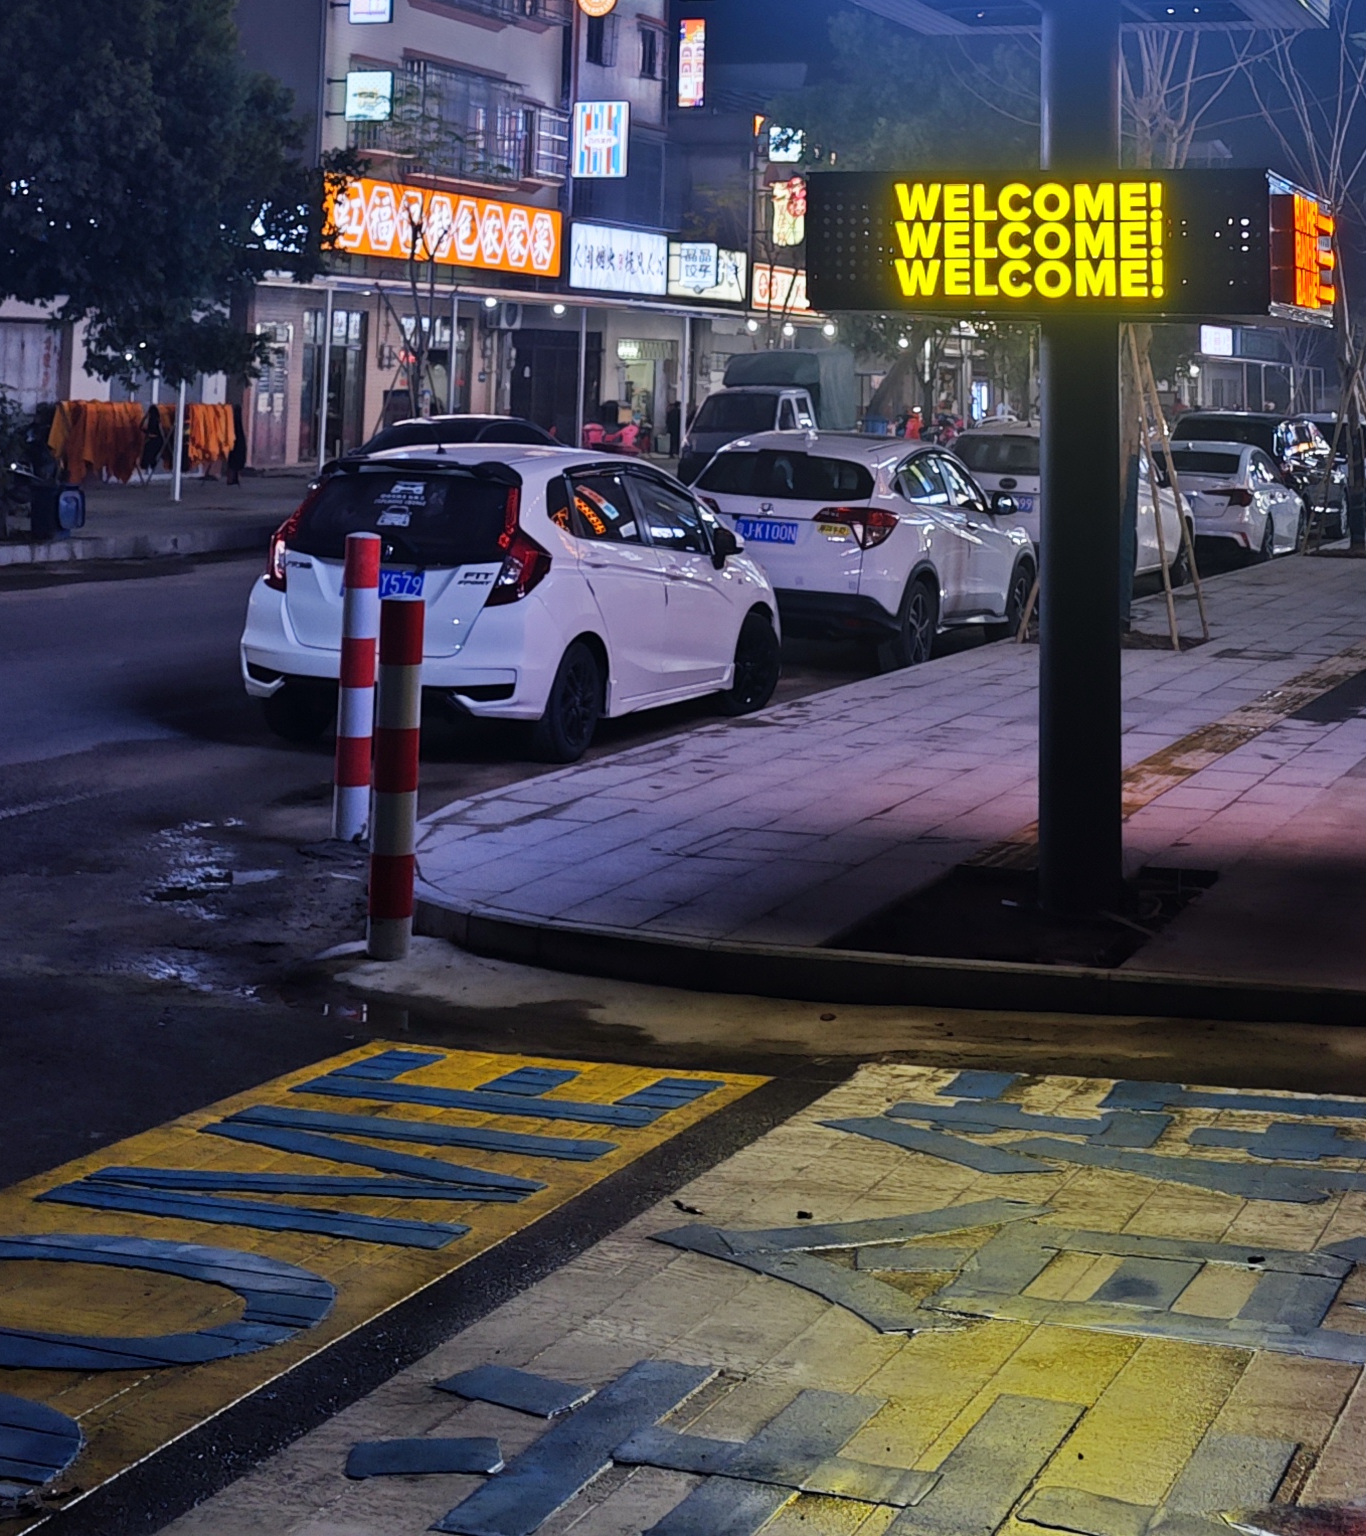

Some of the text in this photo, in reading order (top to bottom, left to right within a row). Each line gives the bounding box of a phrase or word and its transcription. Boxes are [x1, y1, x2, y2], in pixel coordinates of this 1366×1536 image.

[895, 182, 1164, 221] WELCOME!
[895, 221, 1164, 260] WELCOME!
[895, 260, 1165, 299] WELCOME!
